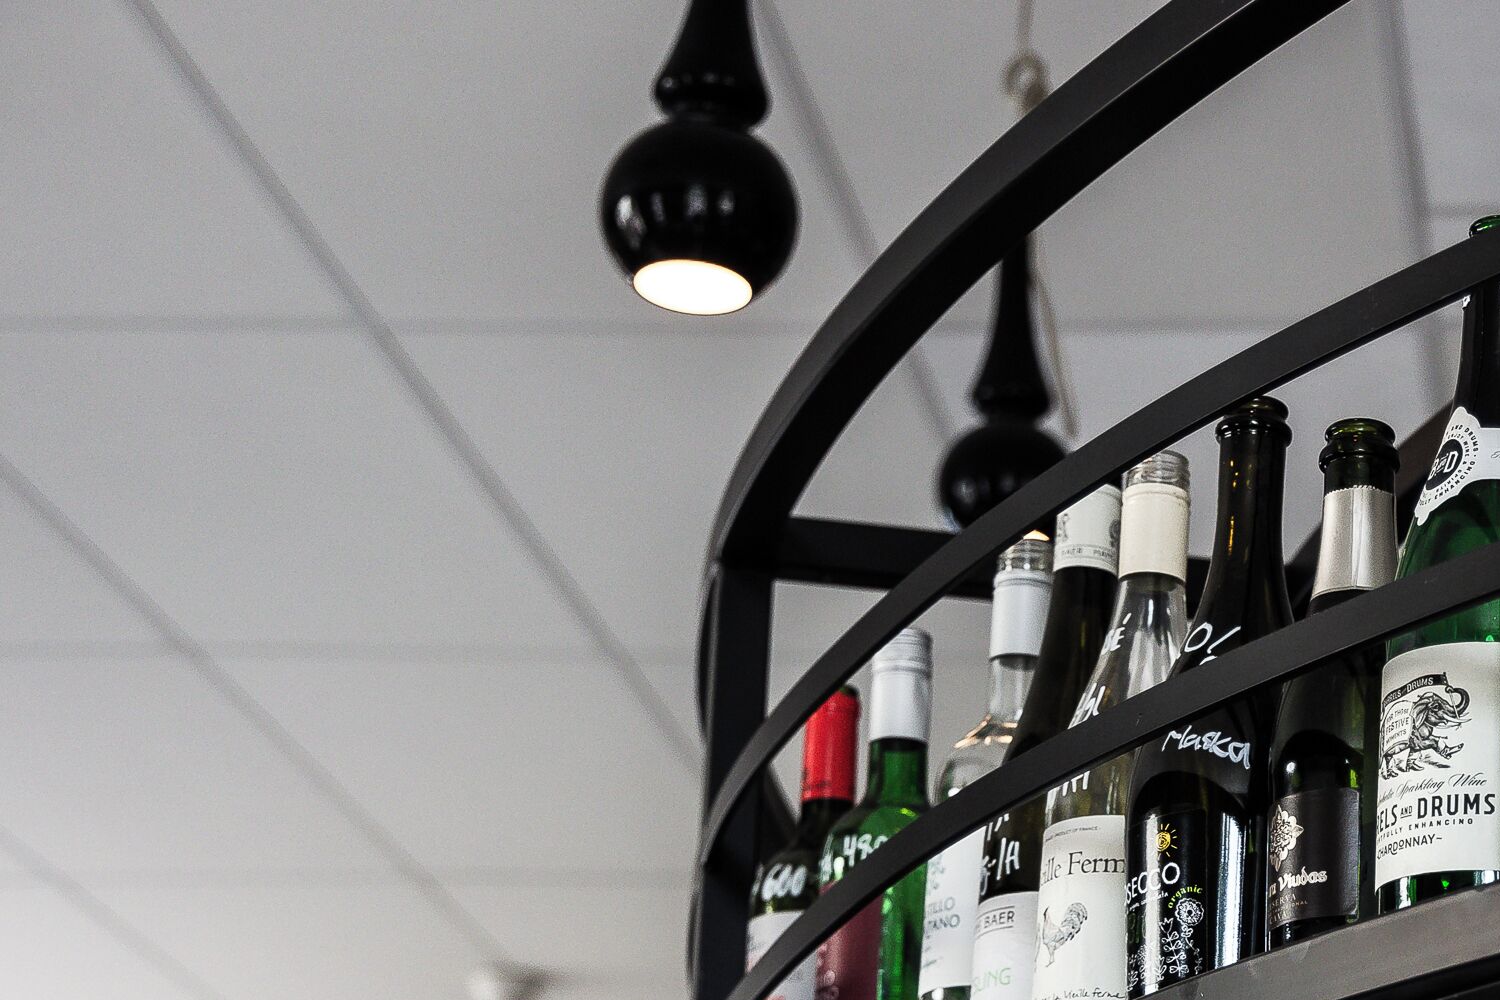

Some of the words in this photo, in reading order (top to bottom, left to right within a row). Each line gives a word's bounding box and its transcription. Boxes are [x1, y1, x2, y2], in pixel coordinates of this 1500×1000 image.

[1448, 772, 1488, 788] Wine
[1417, 793, 1496, 820] DRUMS
[1408, 818, 1474, 831] ENHANCING
[1278, 866, 1328, 892] Viudas
[1168, 884, 1203, 909] organic
[983, 910, 1016, 929] BAER
